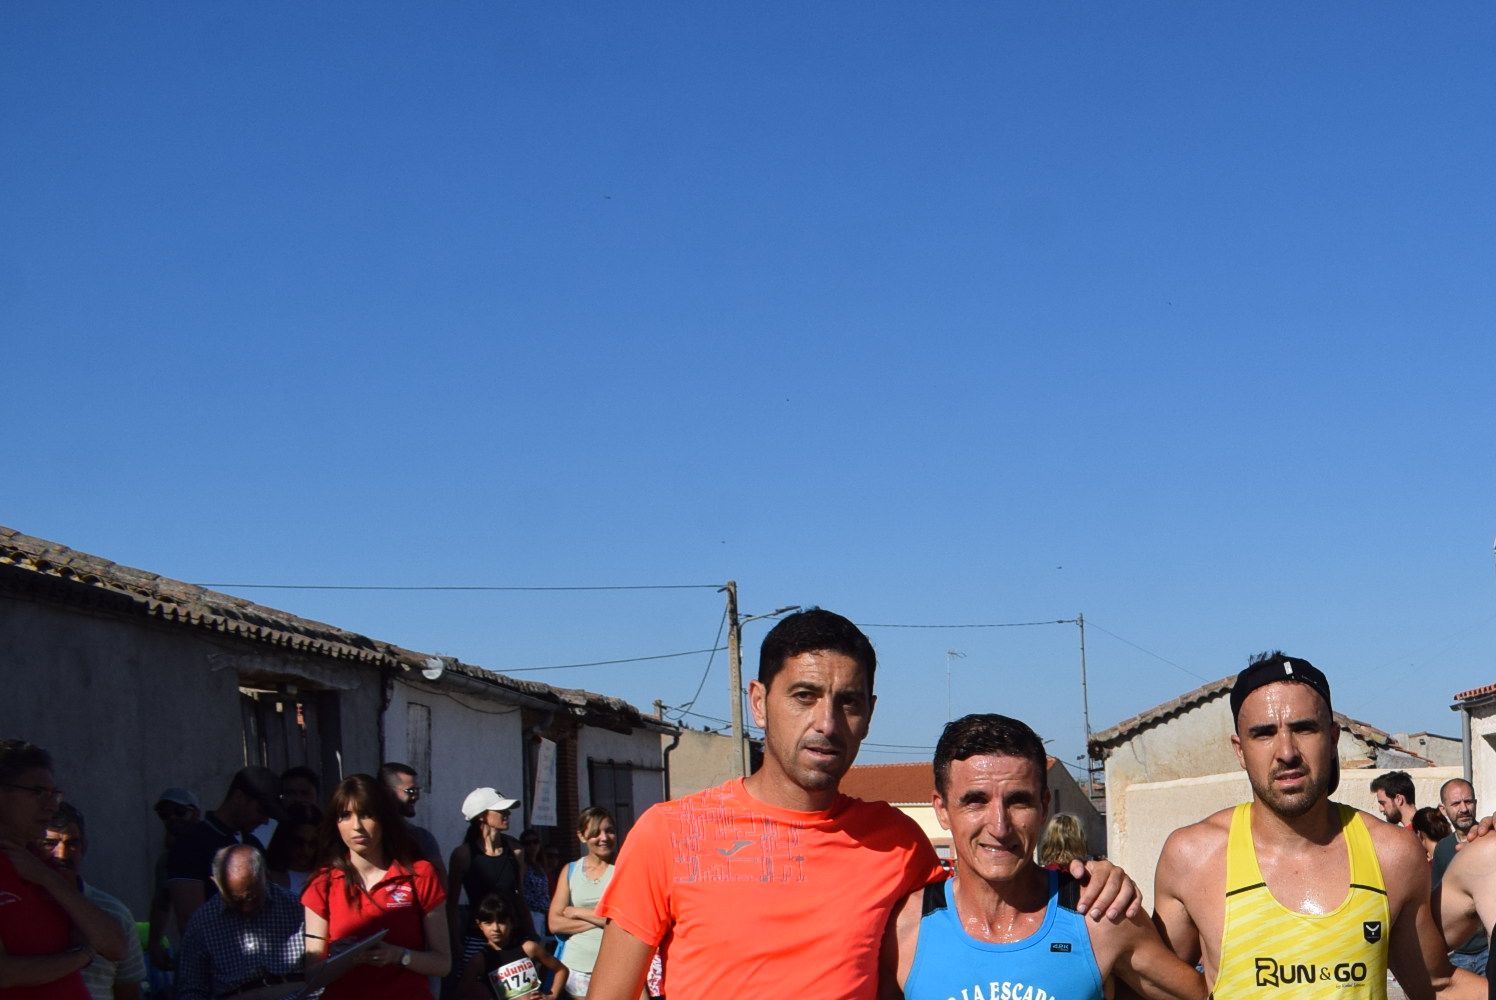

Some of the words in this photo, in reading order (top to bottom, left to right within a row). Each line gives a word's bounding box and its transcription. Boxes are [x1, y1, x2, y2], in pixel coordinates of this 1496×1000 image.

[501, 972, 531, 991] 174
[1254, 957, 1316, 988] RUN
[1319, 967, 1331, 981] &
[1334, 962, 1367, 982] GO
